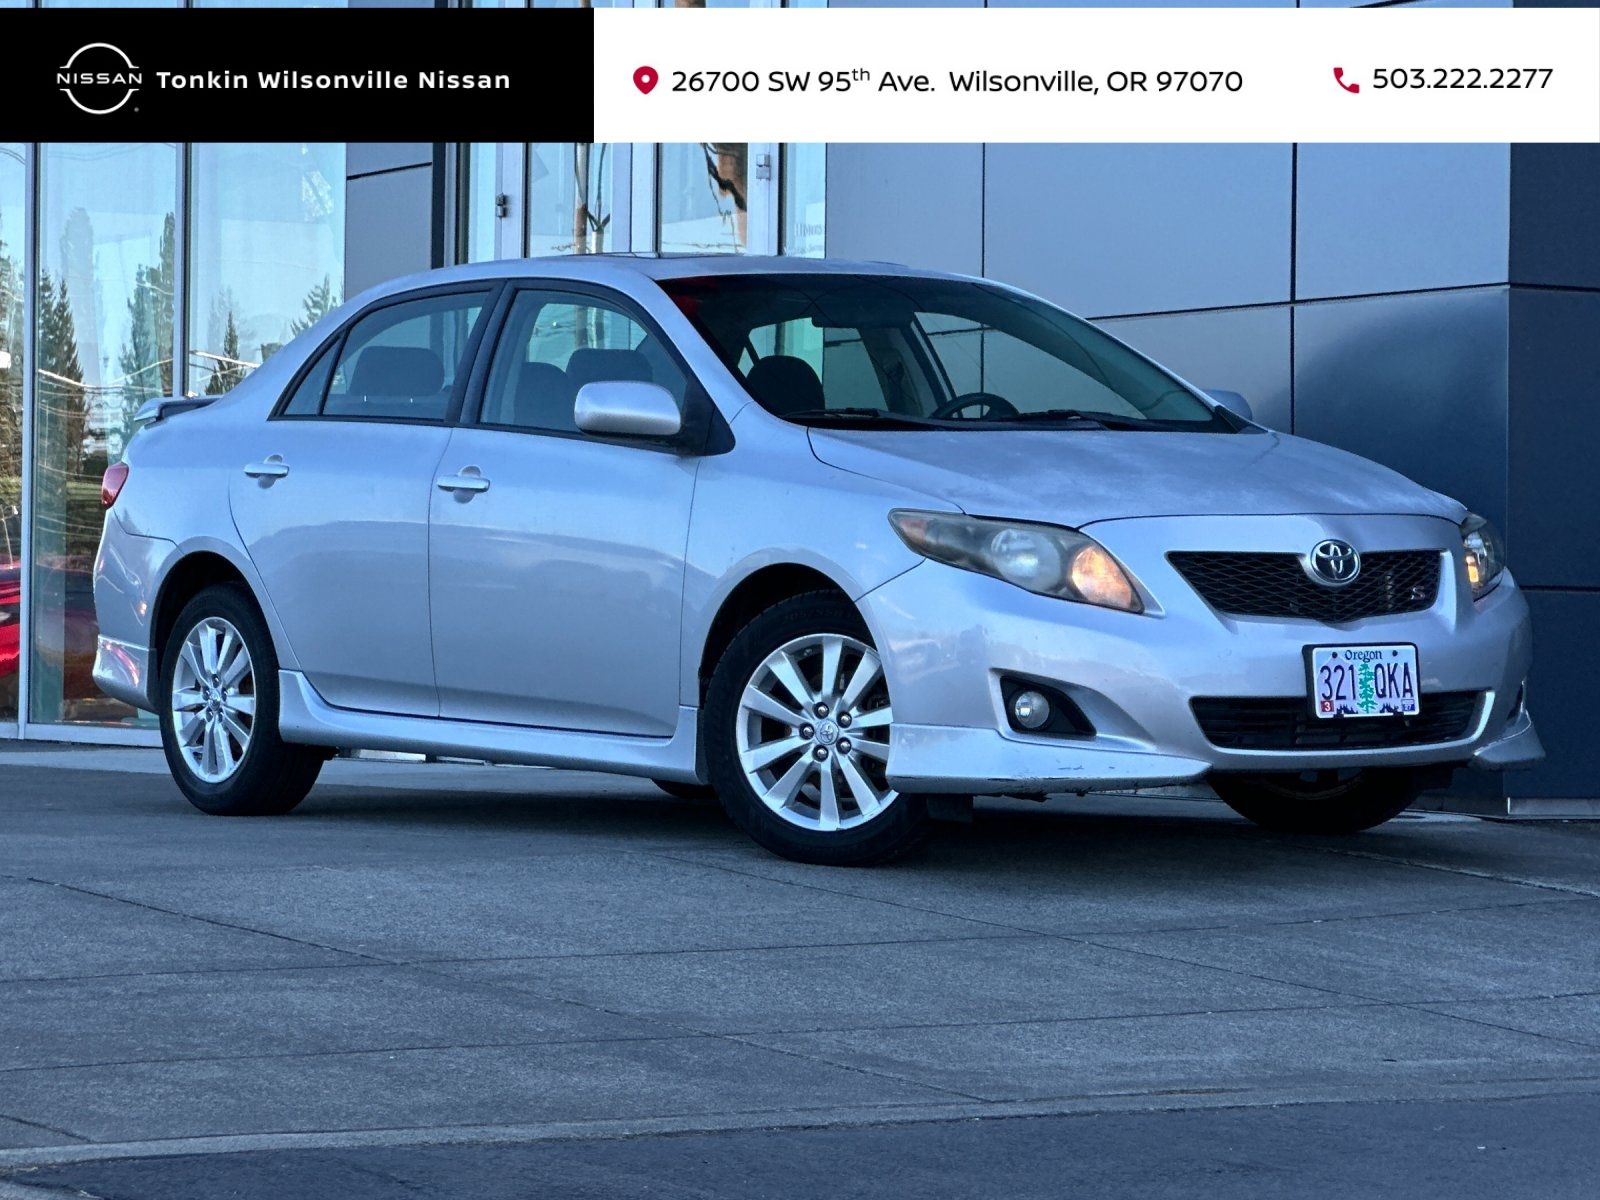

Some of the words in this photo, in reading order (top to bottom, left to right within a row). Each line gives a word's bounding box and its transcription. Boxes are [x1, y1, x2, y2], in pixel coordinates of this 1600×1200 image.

[1345, 649, 1383, 663] Oregon
[1320, 664, 1357, 700] 321
[1374, 662, 1413, 698] QKA
[1324, 701, 1331, 712] 3
